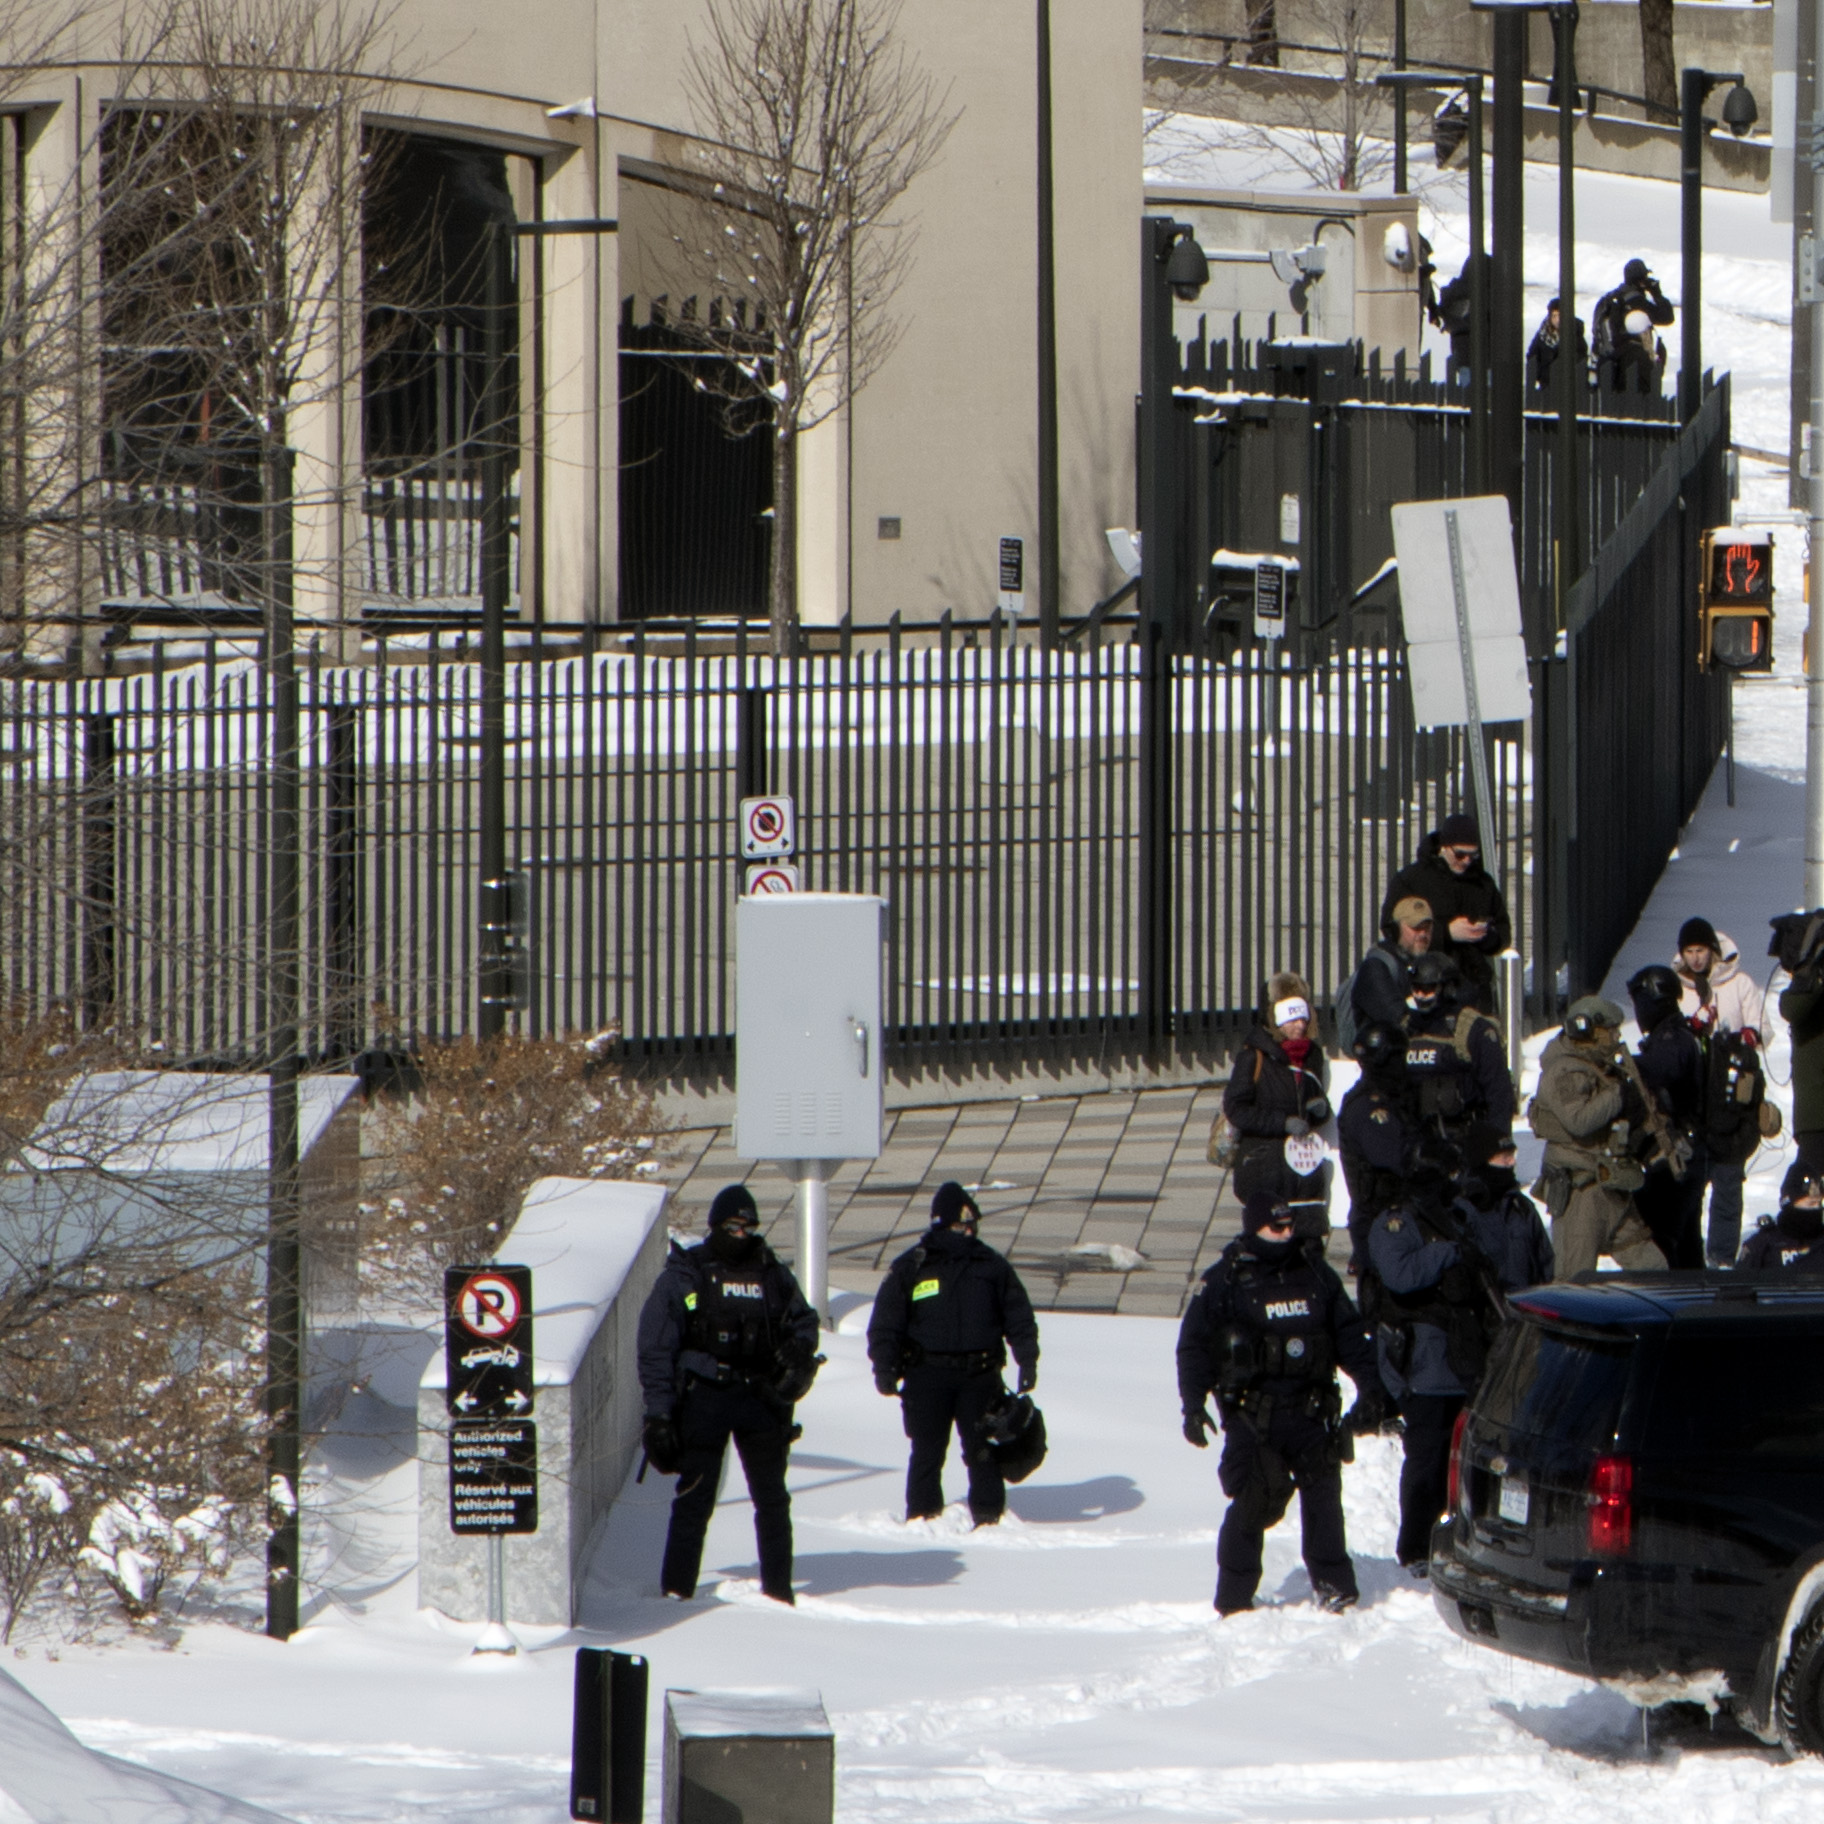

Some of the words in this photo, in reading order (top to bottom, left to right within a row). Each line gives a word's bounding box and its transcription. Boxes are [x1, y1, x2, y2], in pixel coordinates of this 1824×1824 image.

[722, 1282, 764, 1298] POLIC
[1265, 1299, 1310, 1320] POLICE
[453, 1429, 524, 1443] Authorized
[453, 1445, 507, 1457] vehicles
[455, 1481, 508, 1496] Réservé
[509, 1485, 534, 1495] aux
[455, 1497, 516, 1511] véhicules
[456, 1512, 516, 1525] autorisés
